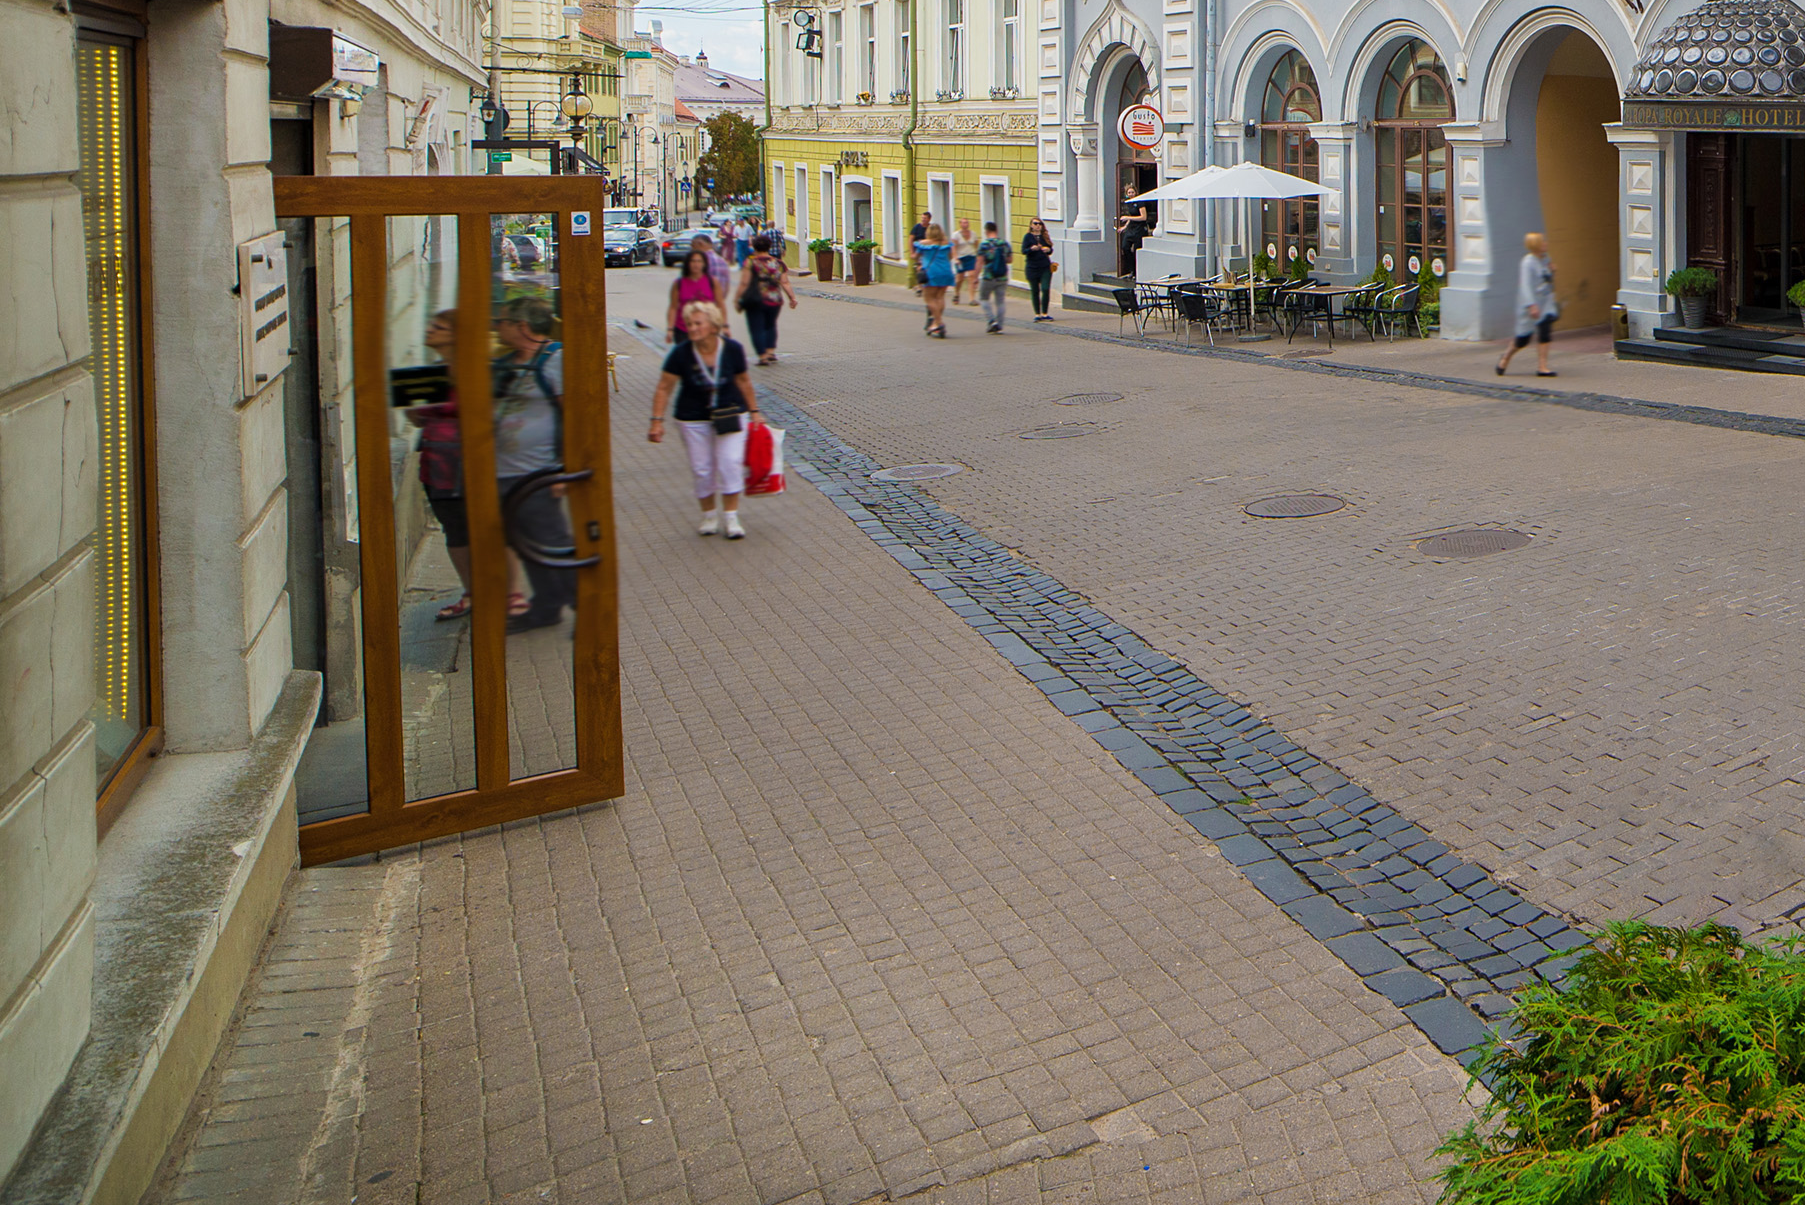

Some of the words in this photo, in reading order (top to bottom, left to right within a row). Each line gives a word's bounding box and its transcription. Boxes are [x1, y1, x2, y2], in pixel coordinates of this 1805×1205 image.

[1132, 110, 1156, 121] Gusto
[1624, 107, 1658, 124] EUROPA
[1664, 107, 1723, 125] ROYALE
[1741, 108, 1805, 126] HOTEL
